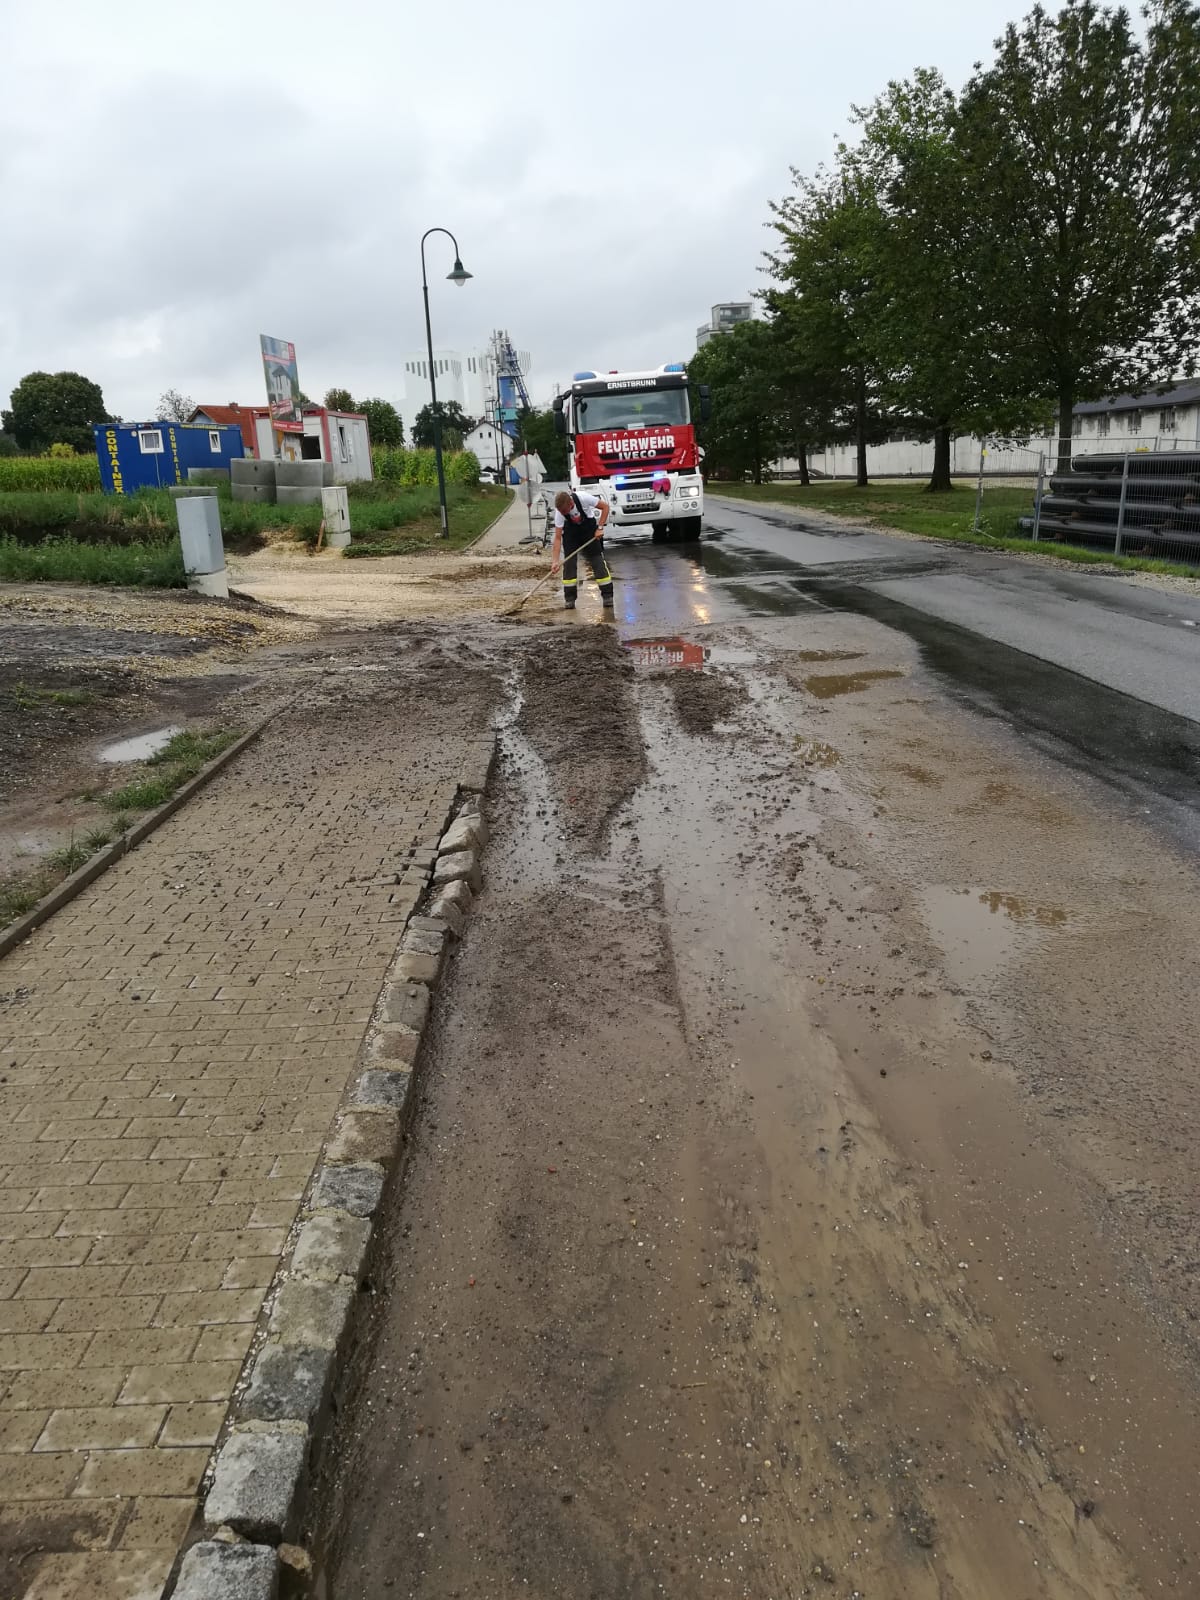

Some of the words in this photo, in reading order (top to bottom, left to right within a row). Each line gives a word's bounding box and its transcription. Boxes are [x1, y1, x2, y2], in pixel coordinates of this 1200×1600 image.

[607, 379, 657, 390] ERNSTBRUNN
[597, 435, 675, 454] FEUERWEHR
[106, 430, 123, 494] CONTAINEX
[618, 449, 657, 461] IVECO
